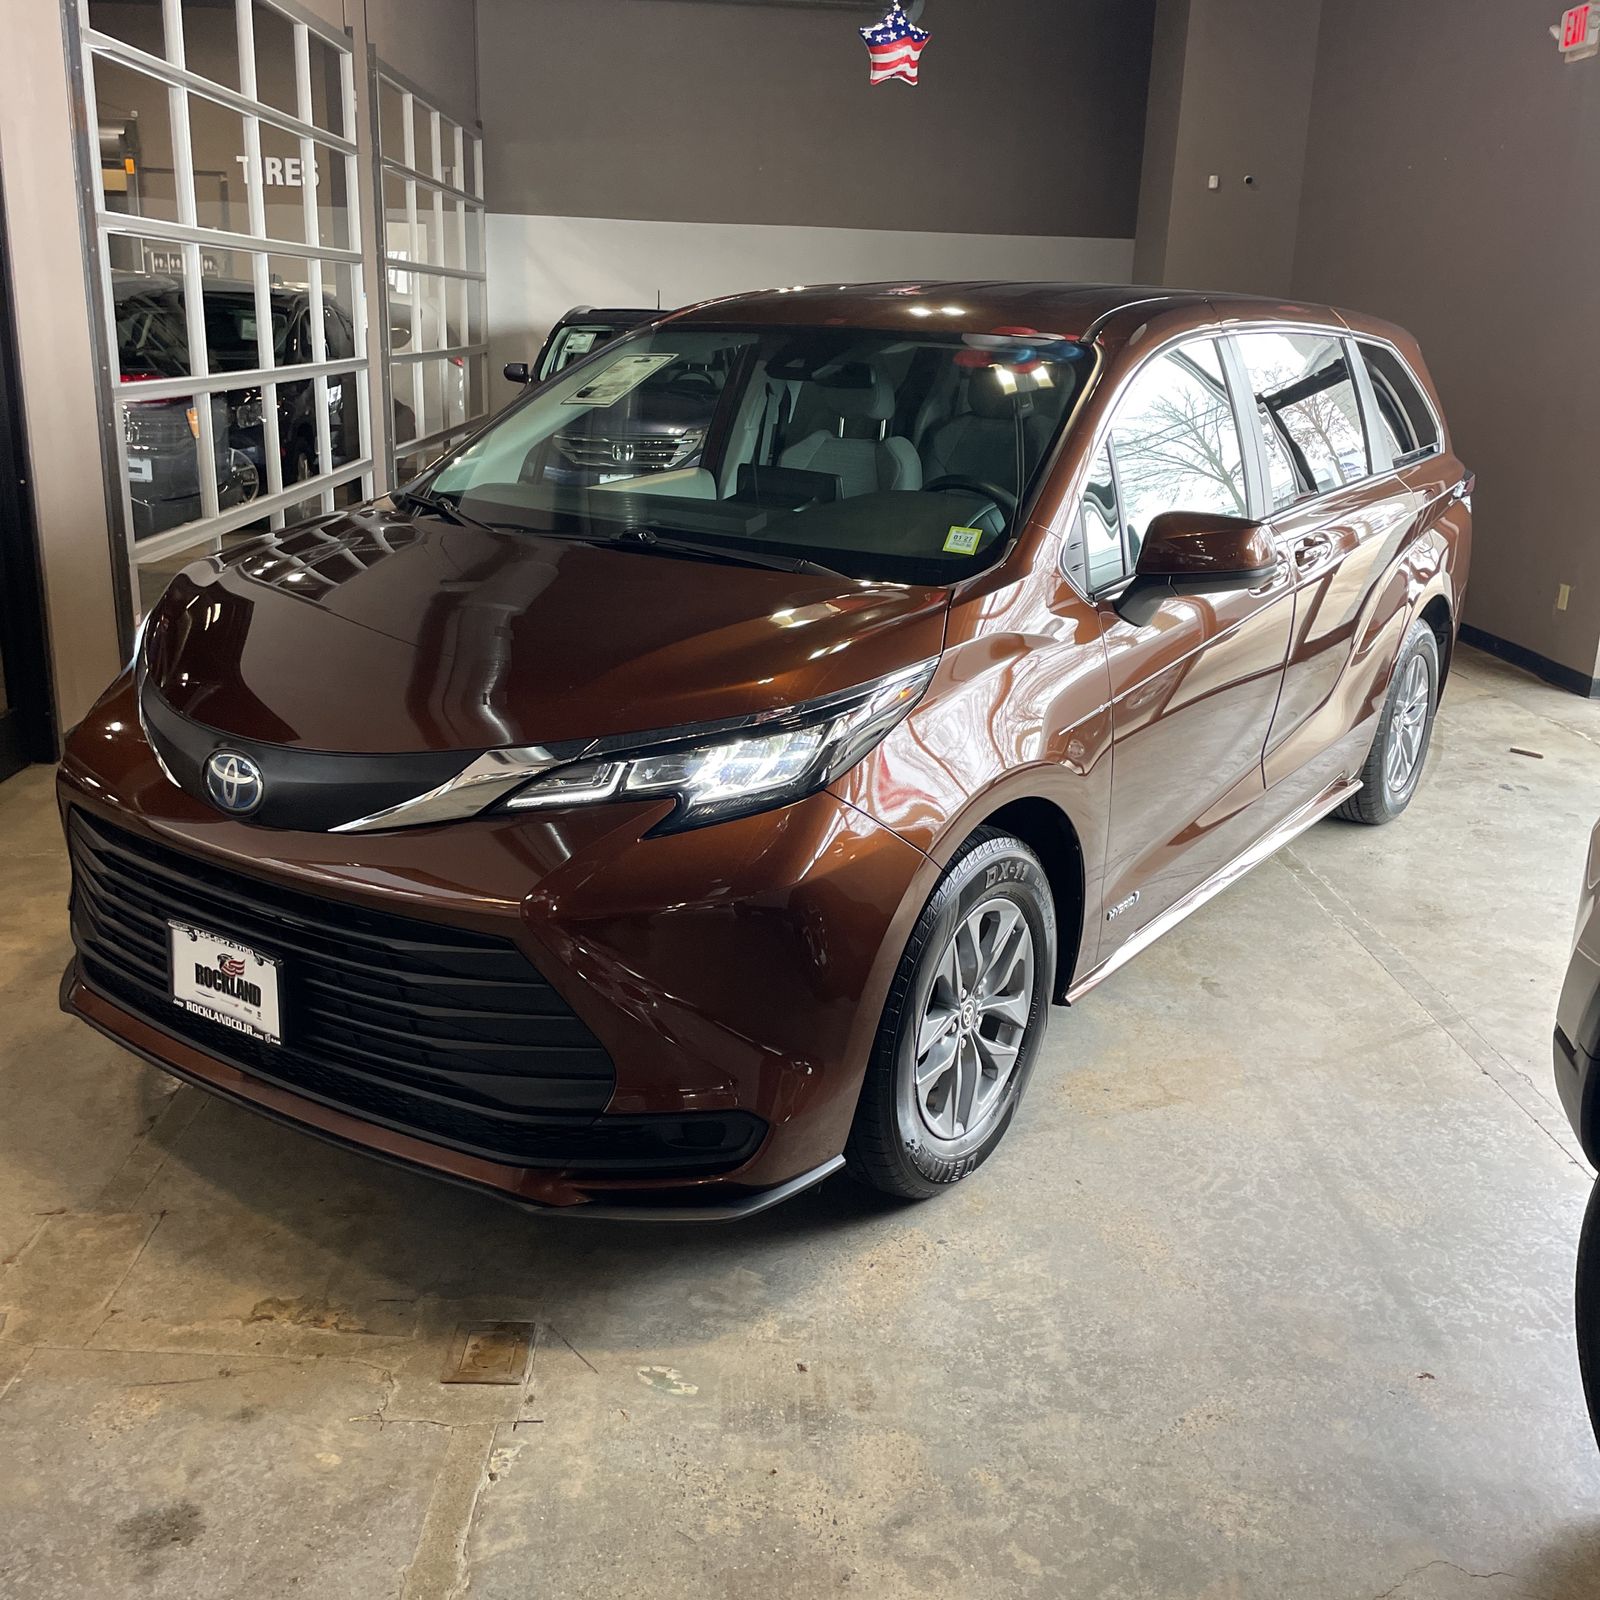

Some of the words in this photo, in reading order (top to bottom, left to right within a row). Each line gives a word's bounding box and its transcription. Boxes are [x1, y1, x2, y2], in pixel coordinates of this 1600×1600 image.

[1563, 6, 1590, 48] EXIT
[236, 156, 319, 186] TRE
[195, 962, 262, 1007] ROCKLAND
